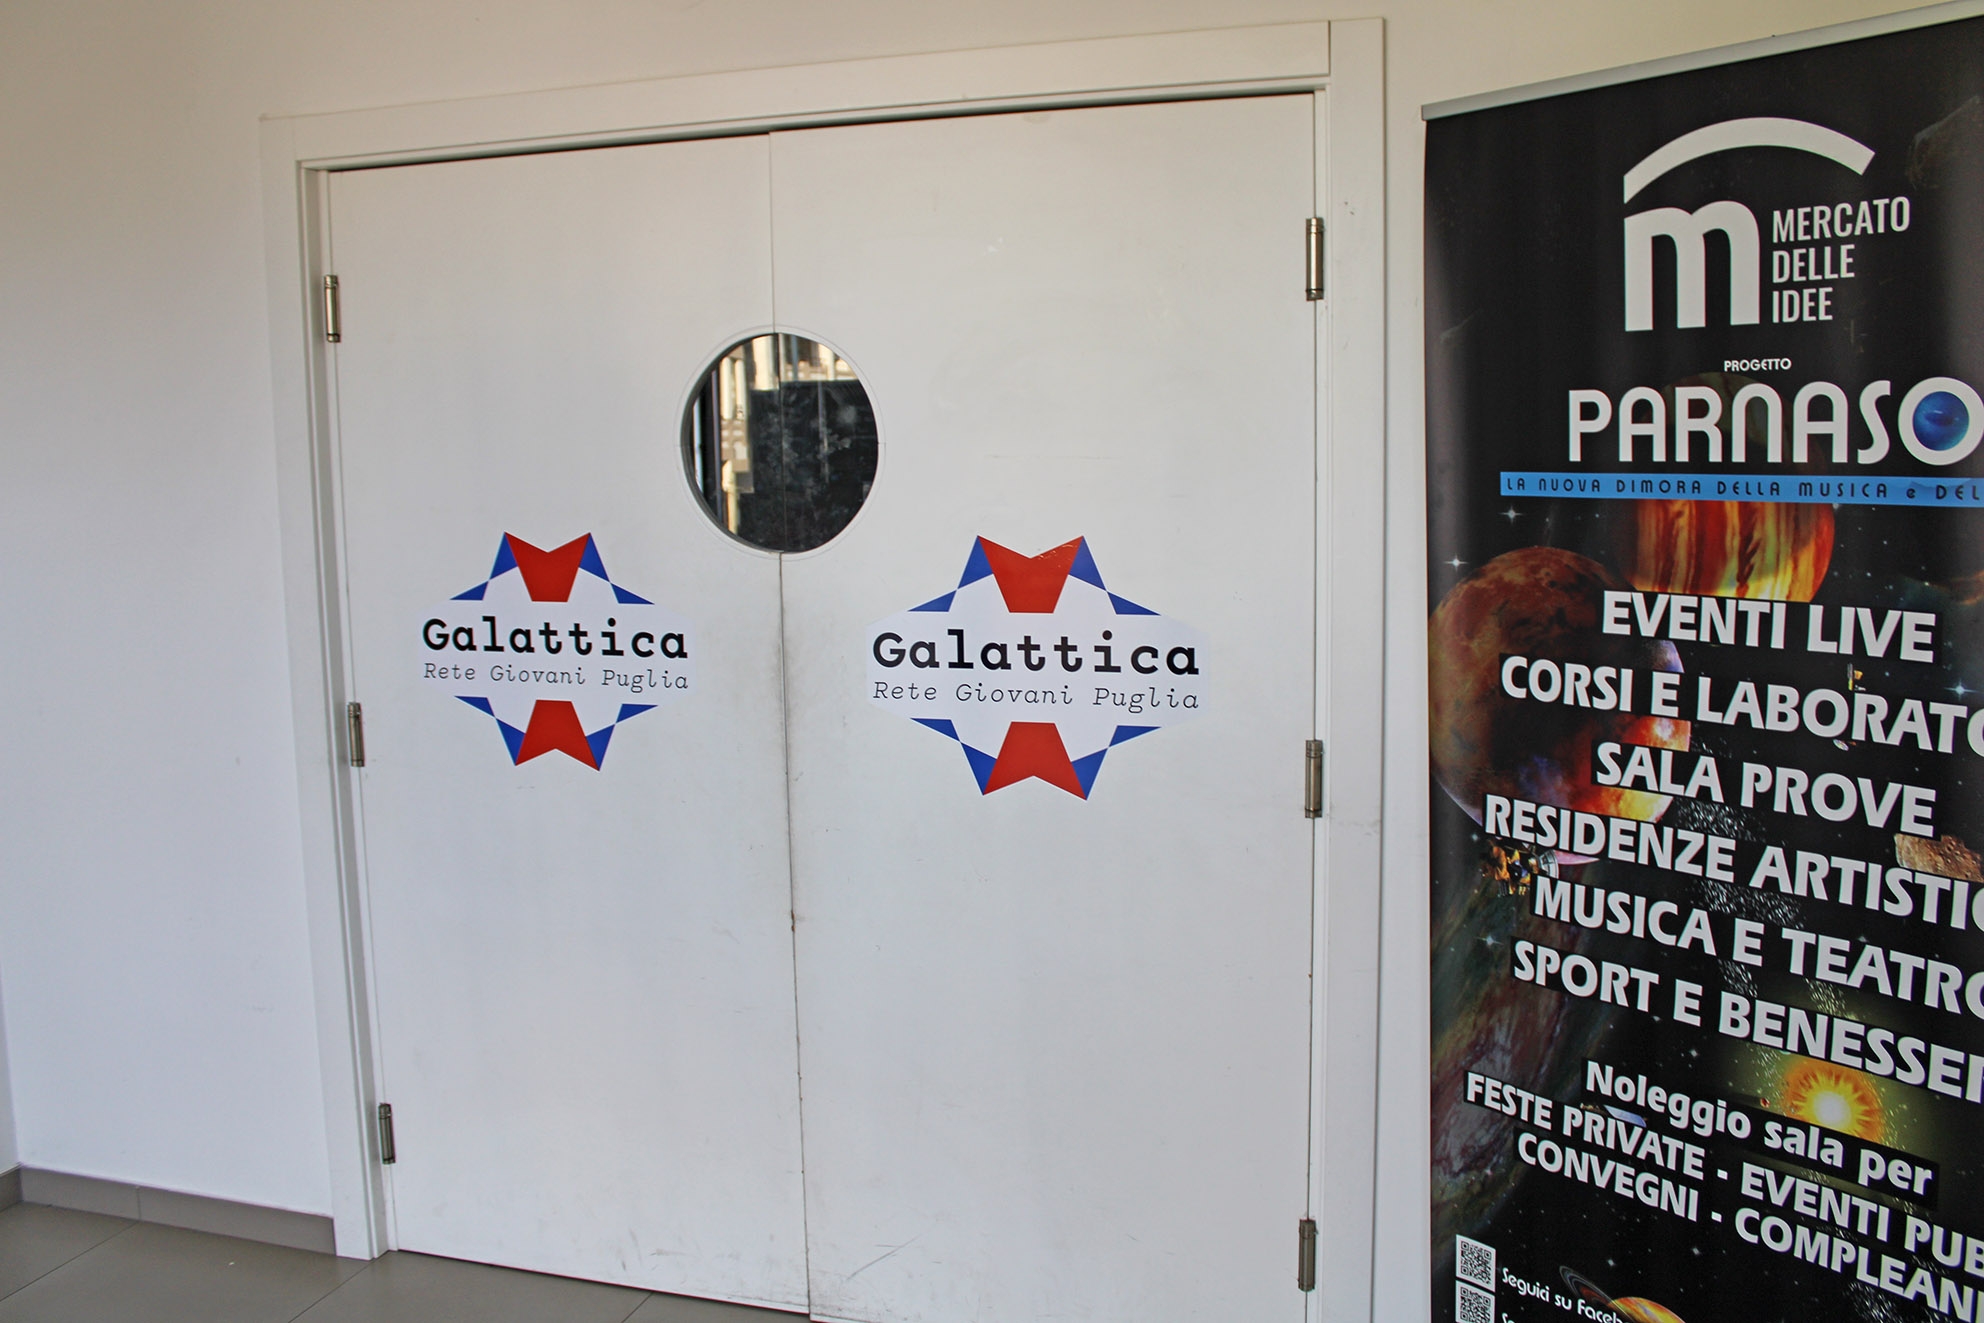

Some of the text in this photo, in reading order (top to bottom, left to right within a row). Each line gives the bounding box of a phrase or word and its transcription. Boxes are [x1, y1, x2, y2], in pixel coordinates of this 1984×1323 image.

[1772, 195, 1910, 244] MERCATO
[1772, 244, 1855, 284] DELLE
[1772, 287, 1833, 324] IDEE
[1723, 357, 1792, 373] PROGETTO
[1568, 376, 1984, 466] PARNASO
[1507, 477, 1526, 492] LA
[1538, 478, 1601, 493] NUOVA
[1616, 479, 1701, 495] DIMORA
[1717, 480, 1781, 497] DELLA
[1799, 481, 1888, 498] MUSICA
[1906, 487, 1916, 499] e
[422, 615, 688, 659] Galattica
[872, 628, 1200, 676] Galattica
[1602, 590, 1936, 663] EVENTI LIVE
[423, 662, 689, 694] Rete Giovani Puglia
[872, 681, 1200, 715] Rete Giovani Puglia
[1501, 656, 1633, 712] CORSI
[1650, 671, 1680, 717] E
[1596, 742, 1937, 838] SALA PROVE
[1484, 793, 1737, 882] RESIDENZE
[1534, 875, 1717, 956] MUSICA
[1732, 917, 1765, 967] E
[1513, 940, 1660, 1013] SPORT
[1673, 978, 1704, 1027] E
[1586, 1059, 1934, 1197] Noleggio sala per
[1466, 1071, 1552, 1130] FESTE
[1563, 1104, 1705, 1181] PRIVATE
[1741, 1161, 1891, 1243] EVENTI
[1518, 1132, 1699, 1223] CONVEGNI
[1735, 1207, 1984, 1323] COMPLEAN
[1501, 1267, 1550, 1303] Seguici
[1554, 1293, 1573, 1311] su
